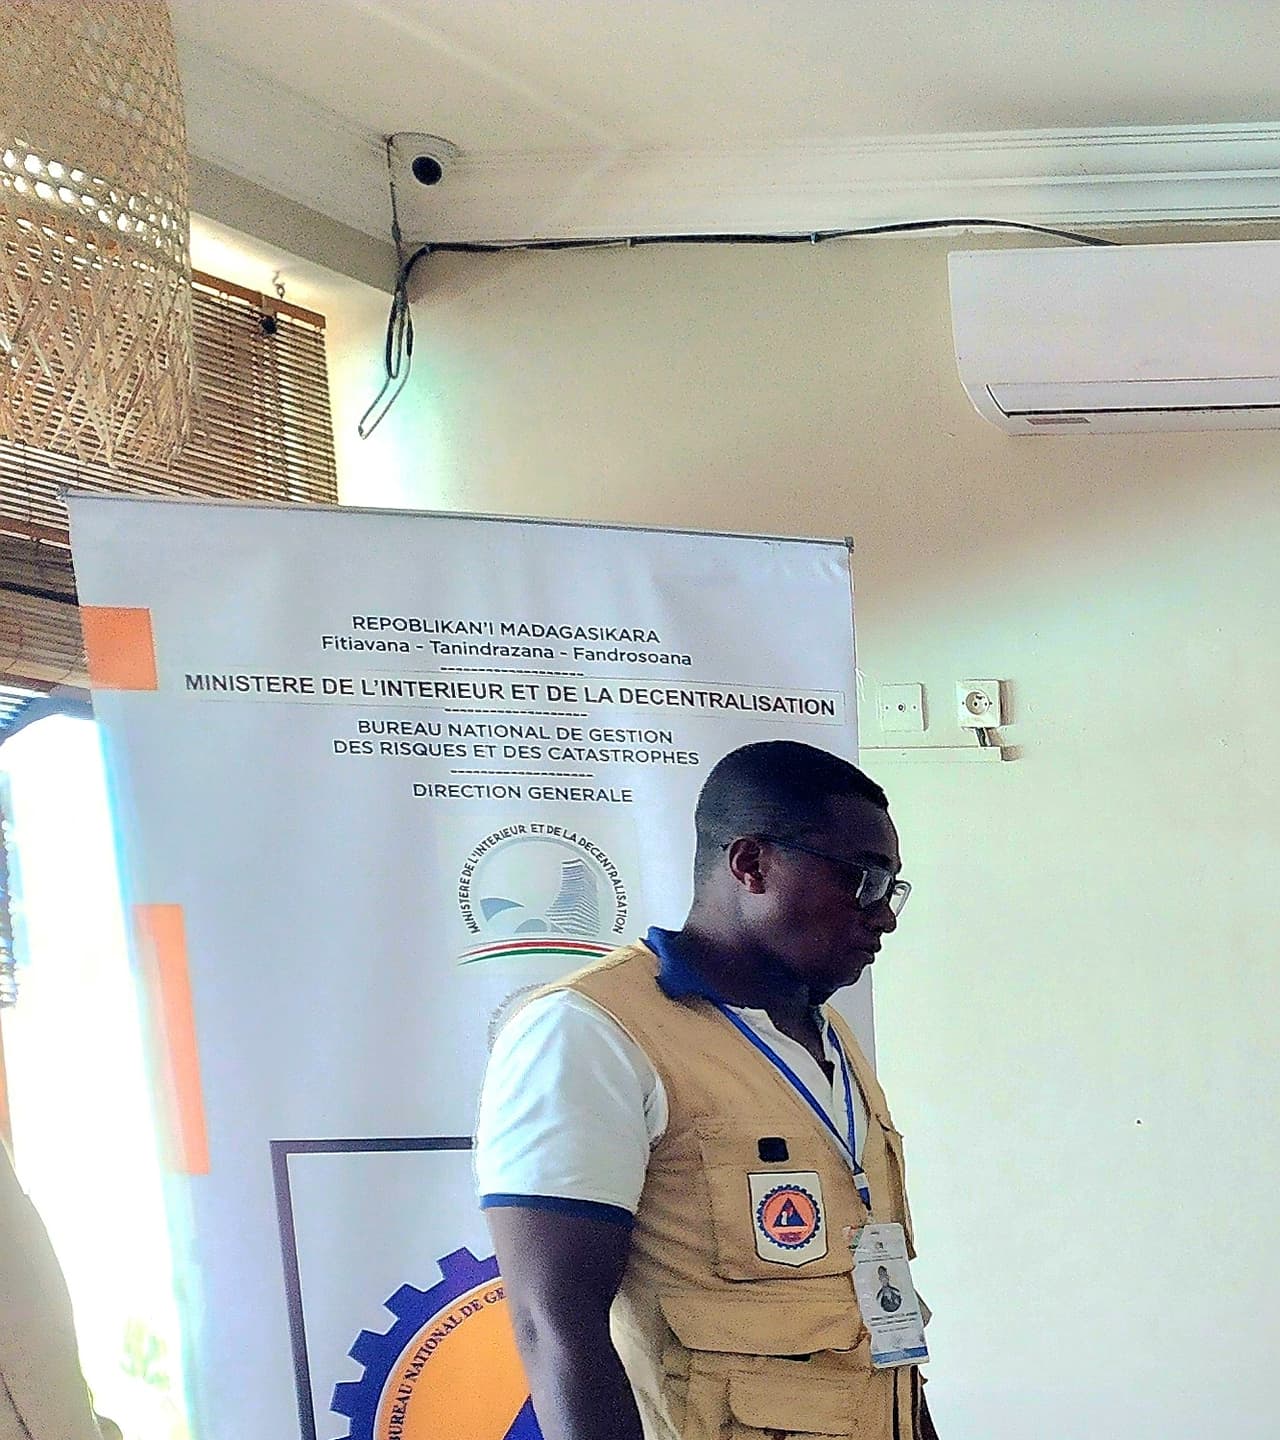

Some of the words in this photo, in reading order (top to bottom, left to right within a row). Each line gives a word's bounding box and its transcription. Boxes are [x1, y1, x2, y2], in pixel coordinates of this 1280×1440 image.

[352, 616, 493, 635] REPOBLIKAN'I
[499, 622, 660, 643] MADAGASIKARA
[322, 635, 409, 653] Fitiavana
[429, 640, 554, 659] Tanindrazana
[573, 647, 692, 666] Fandrosoana
[185, 674, 314, 694] MINISTERE
[322, 678, 354, 695] DE
[361, 679, 505, 699] L'INTERIEUR
[511, 684, 539, 701] ET
[546, 685, 578, 702] DE
[585, 686, 613, 704] LA
[619, 688, 835, 716] DECENTRALISATION
[358, 721, 442, 737] BUREAU
[448, 723, 550, 740] NATIONAL
[557, 727, 583, 741] DE
[589, 728, 672, 744] GESTION
[334, 740, 373, 755] DES
[380, 742, 467, 758] RISQUES
[473, 744, 496, 758] ET
[503, 745, 542, 760] DES
[548, 747, 699, 765] CATASTROPHES
[413, 783, 520, 799] DIRECTION
[528, 786, 632, 802] GENERALE
[530, 824, 544, 833] ET
[547, 825, 561, 836] DE
[562, 830, 577, 843] LA
[462, 863, 475, 877] DE
[578, 837, 629, 934] DECENTRALISATION
[458, 878, 480, 934] MINISTERE
[404, 1315, 463, 1382] NATIONAL
[459, 1299, 483, 1318] DE
